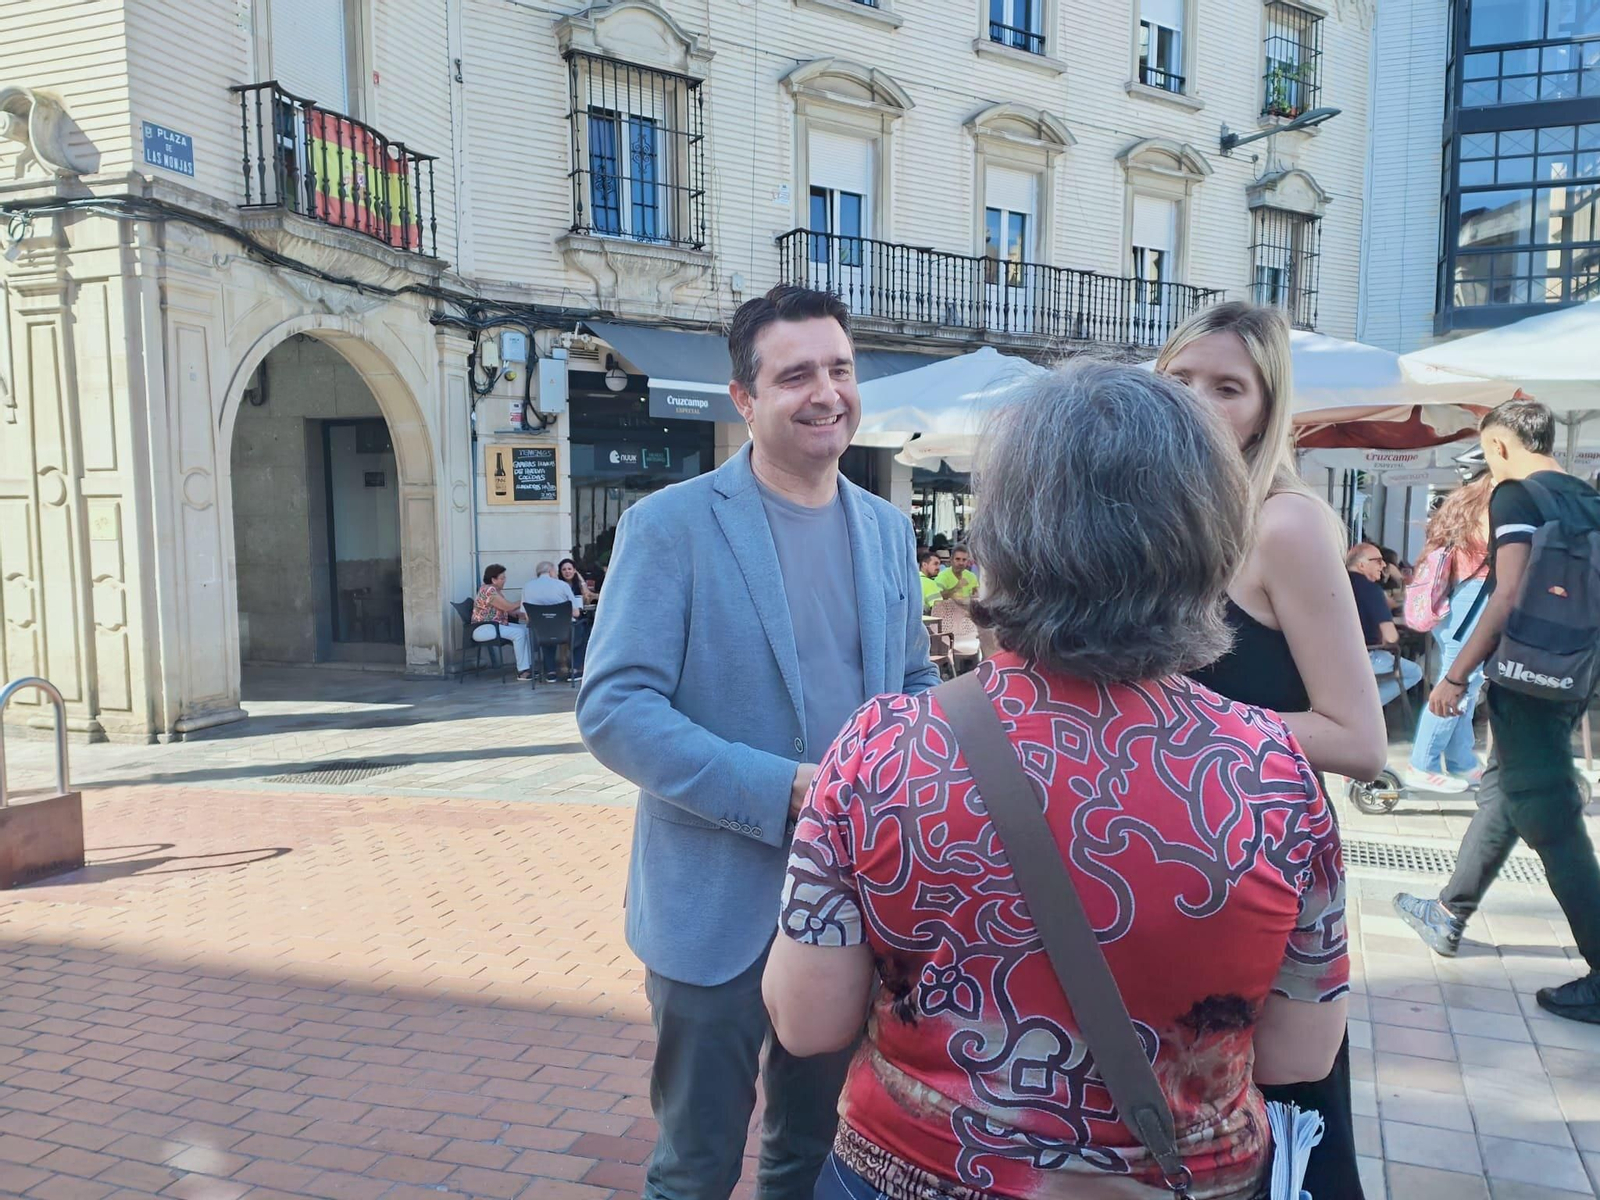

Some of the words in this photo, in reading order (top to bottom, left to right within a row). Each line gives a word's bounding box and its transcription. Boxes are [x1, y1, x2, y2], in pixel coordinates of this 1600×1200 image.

[157, 128, 187, 147] PLAZA
[165, 143, 173, 153] DE
[146, 148, 162, 165] LAS
[163, 153, 193, 174] MONJAS
[667, 395, 709, 408] Cruzcampo
[1365, 453, 1418, 462] Cruzcampo
[1498, 660, 1574, 689] ellesse
